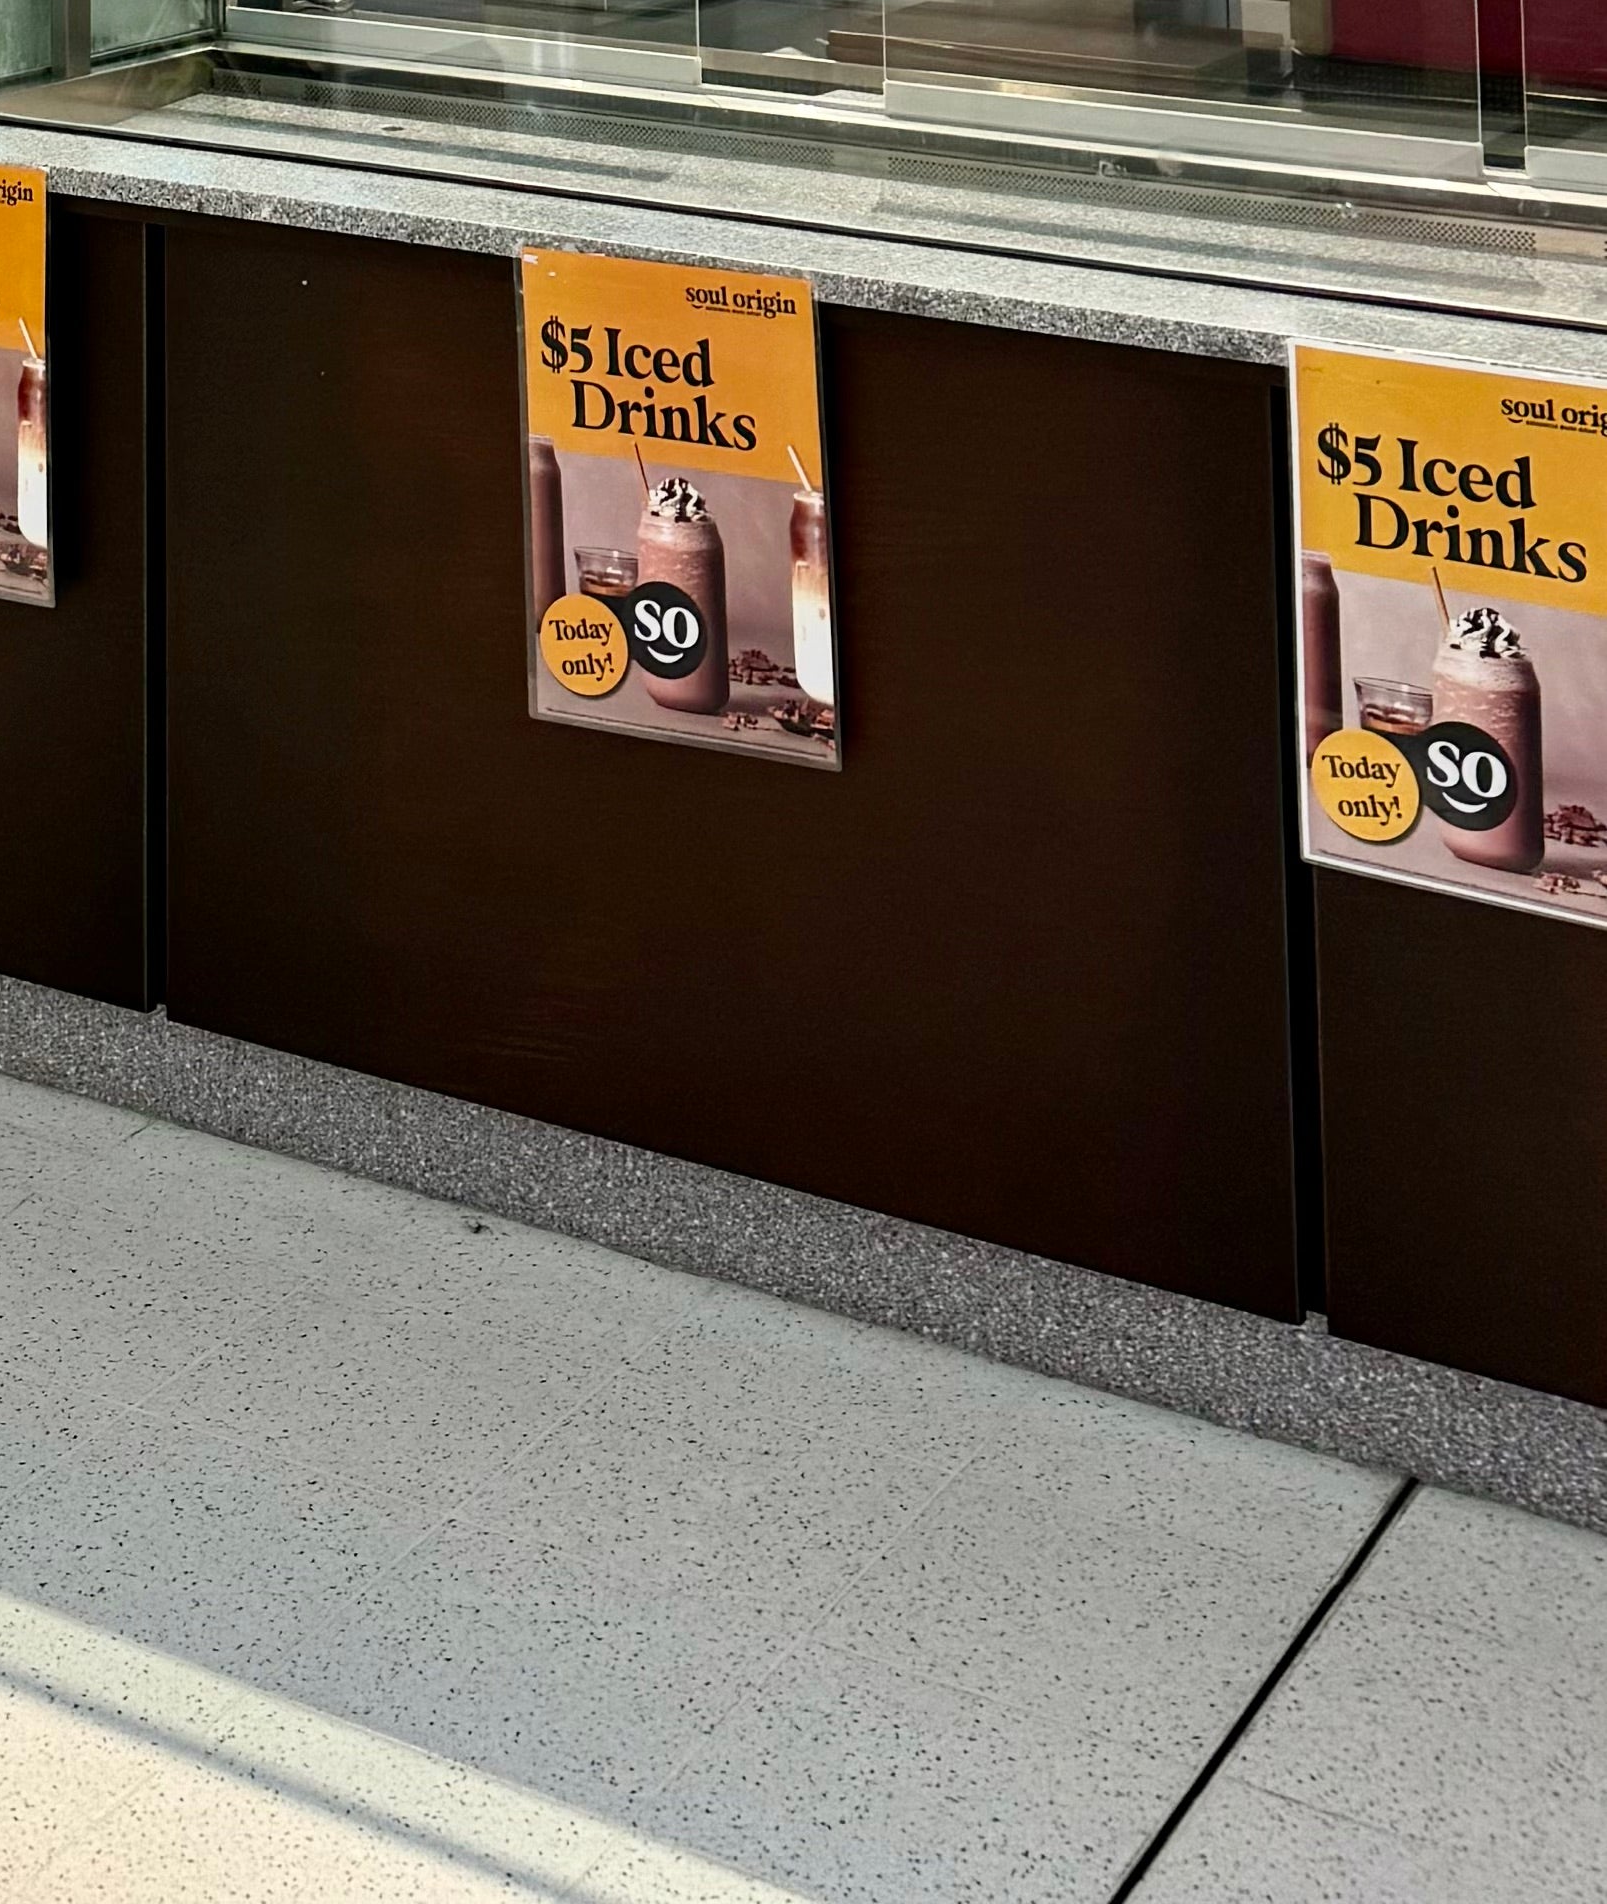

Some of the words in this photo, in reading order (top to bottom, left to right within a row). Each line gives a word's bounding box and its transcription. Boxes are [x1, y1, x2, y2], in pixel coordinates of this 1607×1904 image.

[685, 286, 728, 306] soul
[733, 289, 797, 319] origin
[541, 315, 594, 375] $5
[606, 327, 715, 389] Iced
[570, 379, 757, 452] Drinks
[1501, 398, 1556, 421] soul
[1317, 423, 1383, 486] $5
[1396, 437, 1537, 510] Iced
[1353, 492, 1587, 585] Drinks
[548, 618, 613, 647] Today
[634, 598, 699, 650] SO
[561, 652, 615, 679] only!
[1322, 753, 1401, 788] Today
[1426, 739, 1507, 798] SO
[1337, 795, 1403, 834] only!
